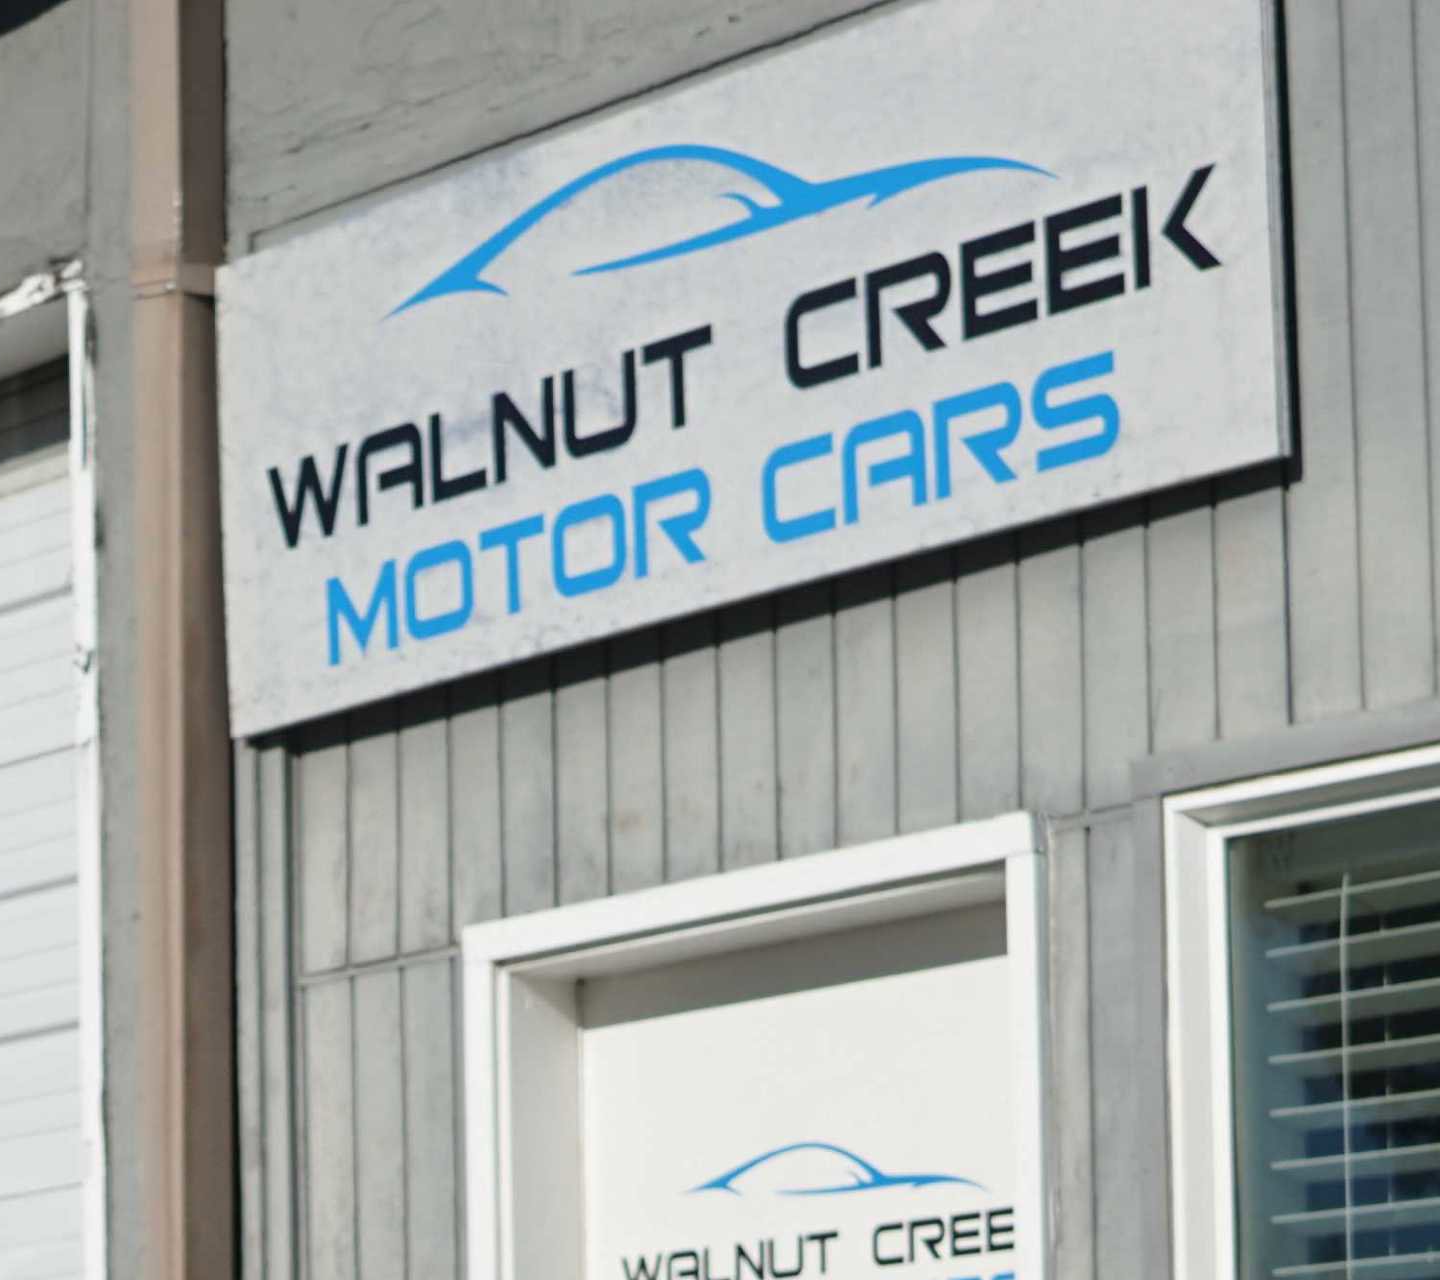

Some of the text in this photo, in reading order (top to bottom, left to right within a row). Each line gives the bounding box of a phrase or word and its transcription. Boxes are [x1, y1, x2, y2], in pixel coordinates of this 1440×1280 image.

[269, 164, 1221, 548] WALNUT CREEK
[325, 351, 1120, 666] MOTOR CARS
[873, 1207, 1015, 1267] CREE
